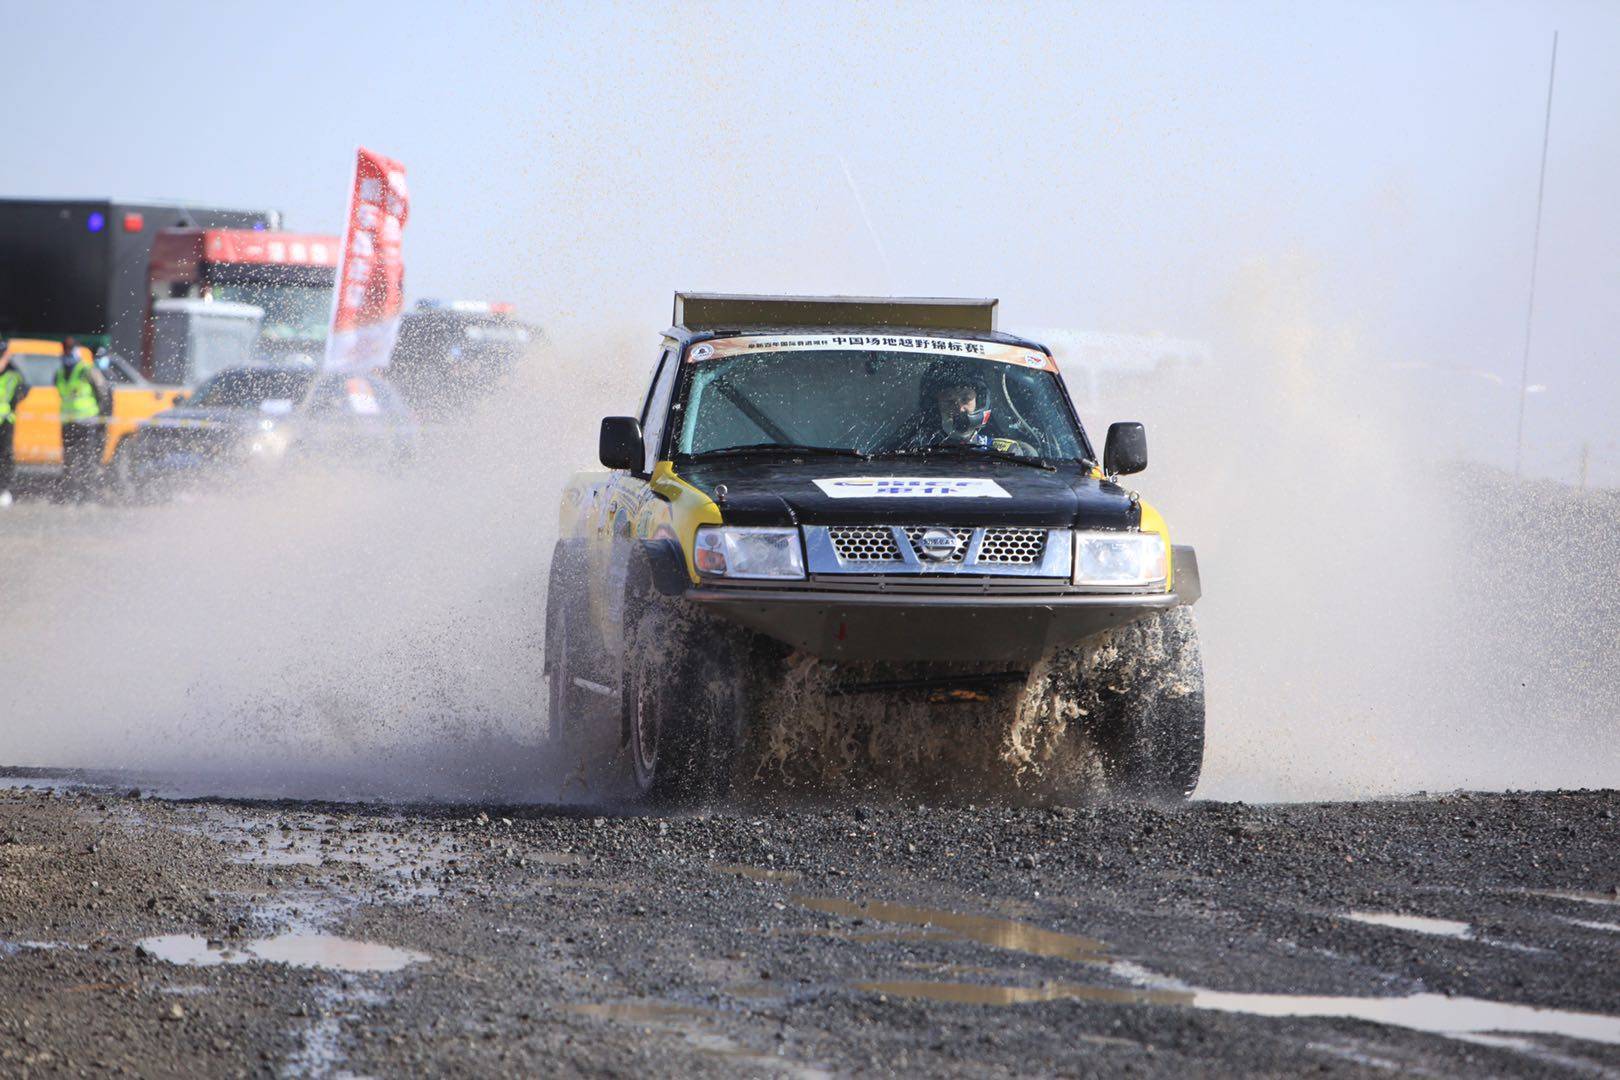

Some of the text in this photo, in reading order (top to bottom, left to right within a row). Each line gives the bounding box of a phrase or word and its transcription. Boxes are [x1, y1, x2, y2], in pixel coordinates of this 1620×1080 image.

[832, 336, 979, 354] 中国场地越野锦标赛
